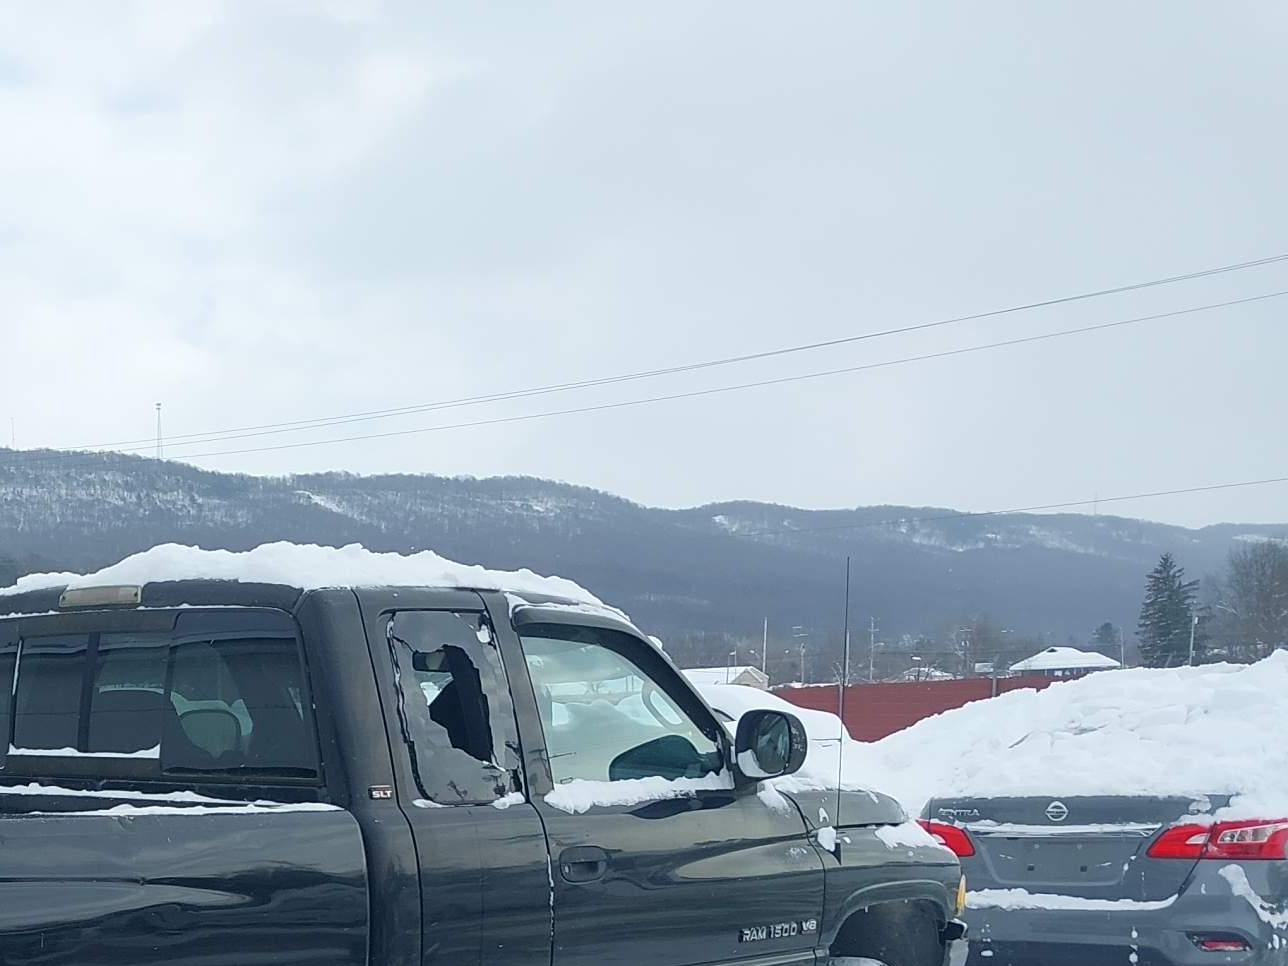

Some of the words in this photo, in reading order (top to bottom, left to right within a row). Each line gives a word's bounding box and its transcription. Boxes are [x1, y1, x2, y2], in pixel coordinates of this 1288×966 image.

[371, 790, 393, 799] SLT
[743, 927, 767, 942] RAM
[770, 922, 798, 938] 1500
[801, 918, 817, 932] V8
